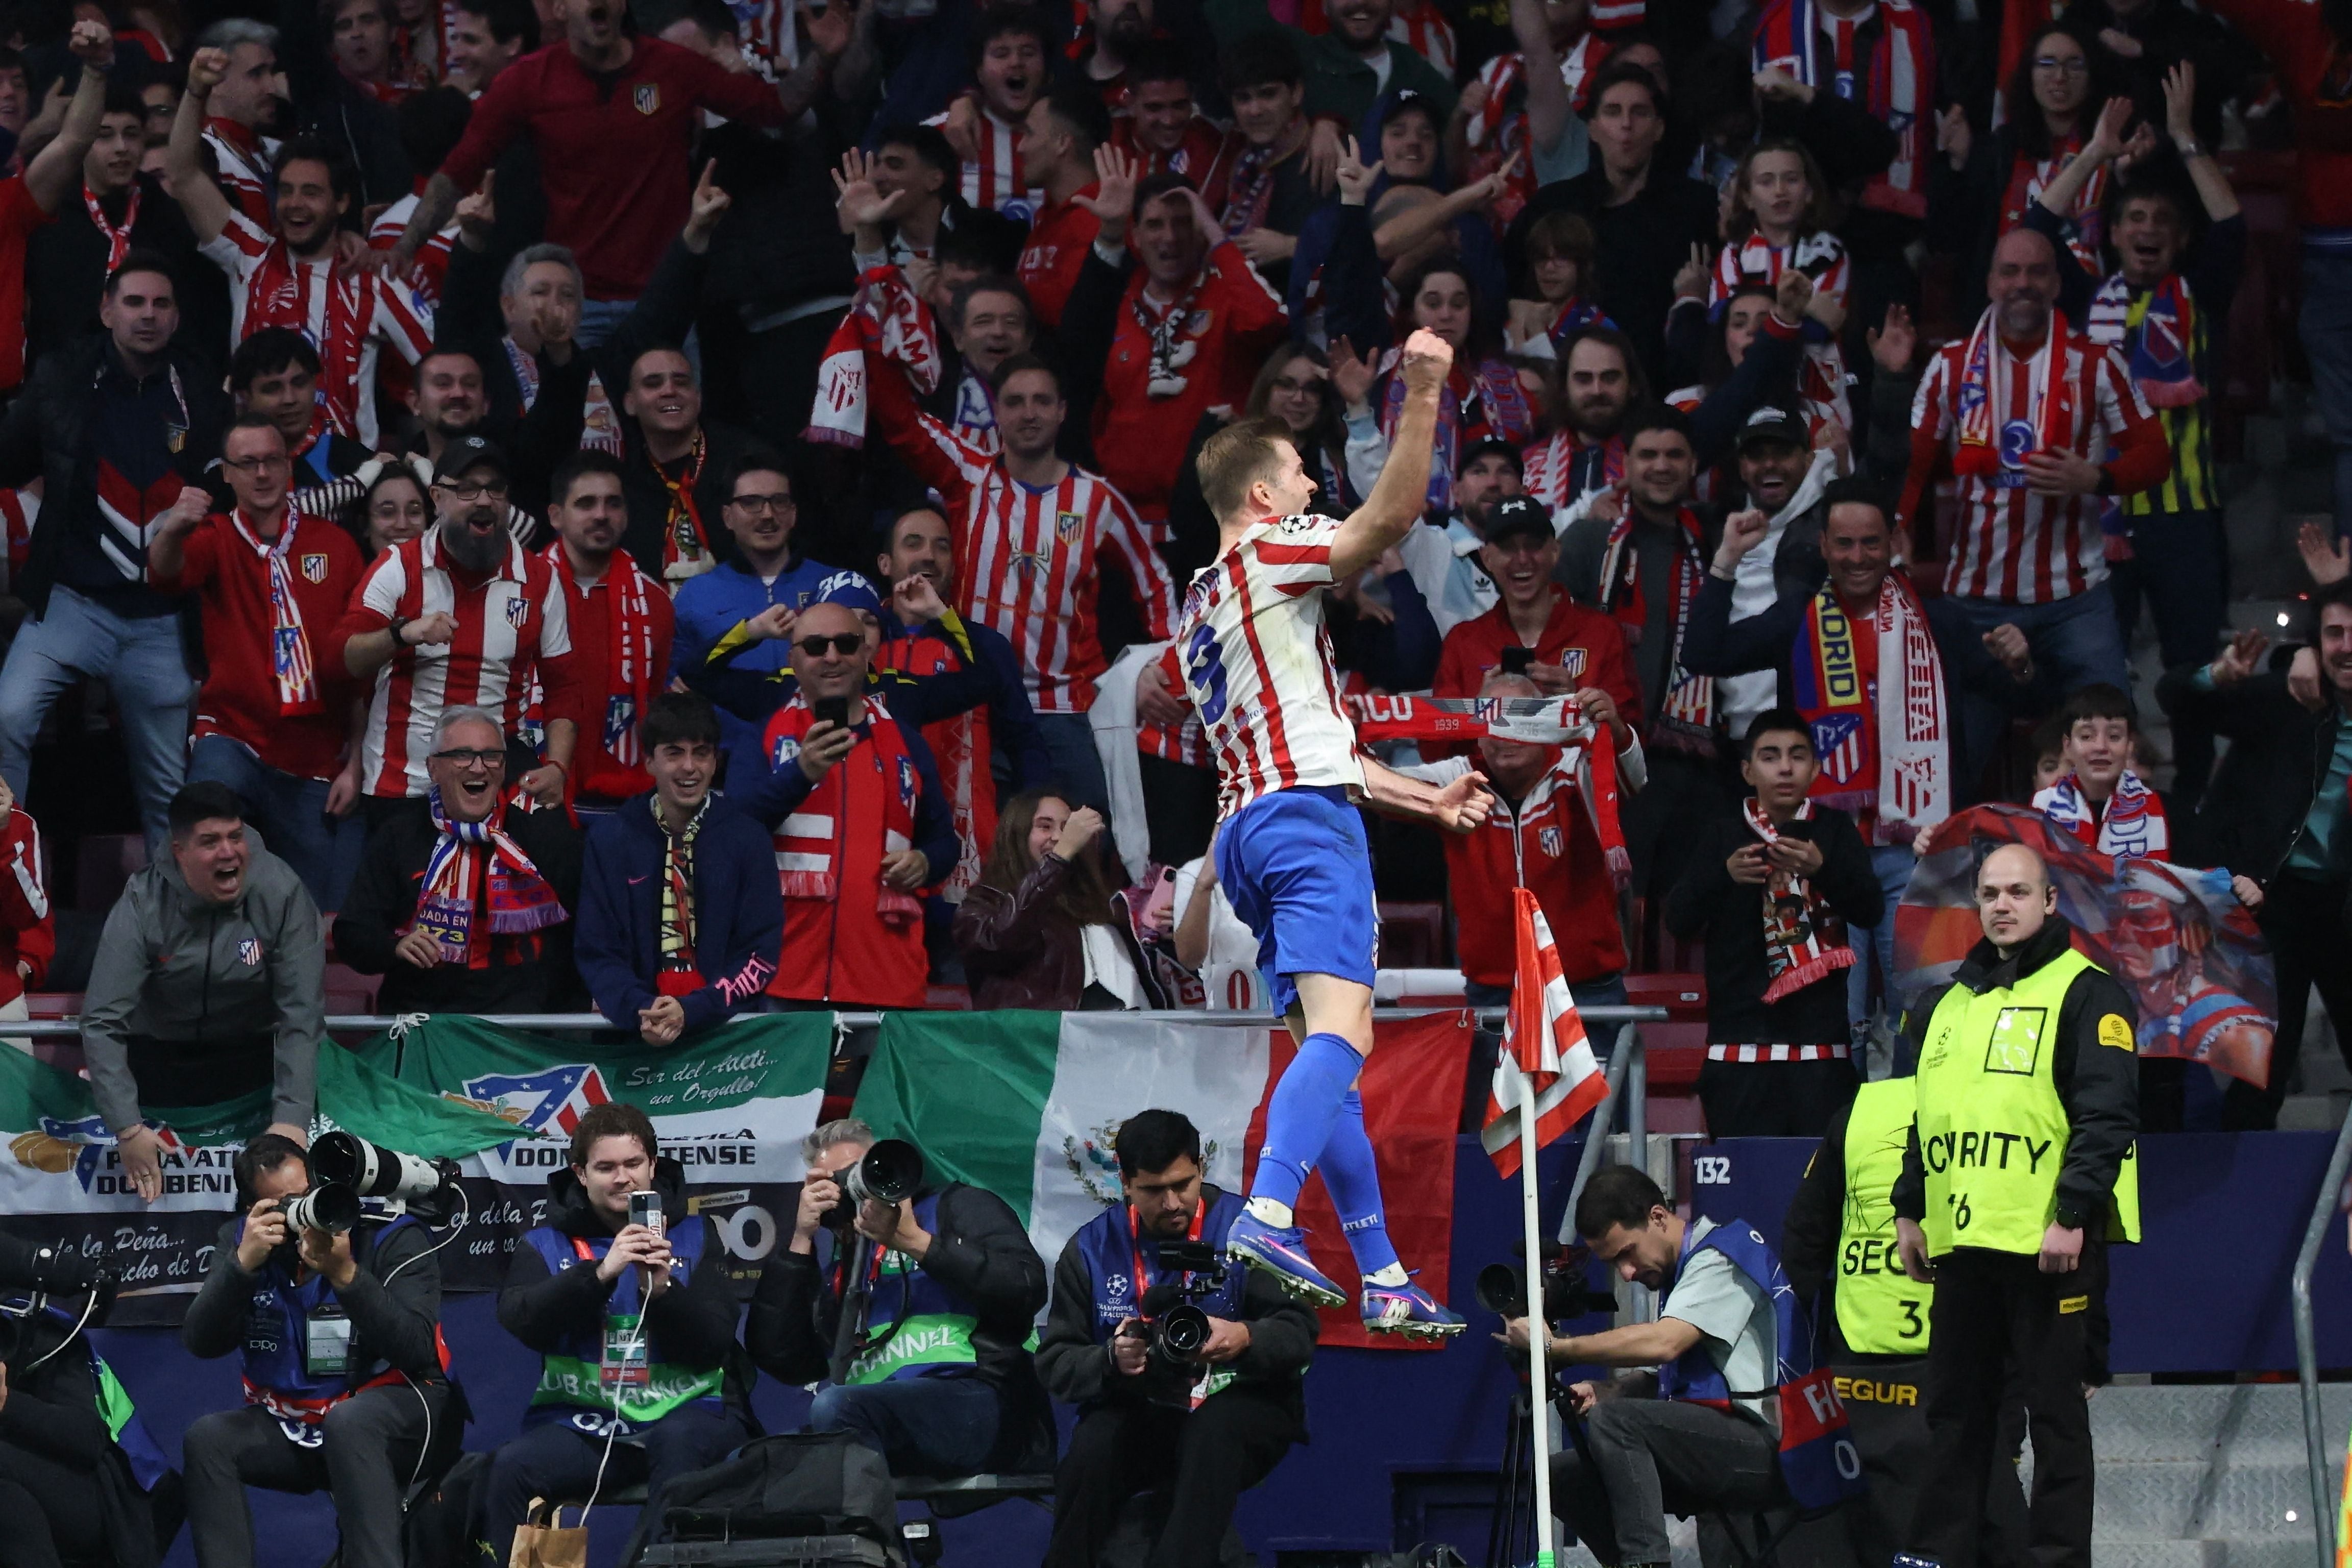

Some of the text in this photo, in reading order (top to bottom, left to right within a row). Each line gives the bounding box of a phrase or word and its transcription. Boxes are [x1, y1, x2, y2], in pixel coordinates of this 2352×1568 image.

[1820, 591, 1856, 698] ADRID
[1186, 623, 1228, 726] 9
[419, 910, 468, 928] DADA EN
[626, 1067, 665, 1087] Ser
[1695, 1156, 1731, 1185] 132
[1342, 1214, 1378, 1232] ATLETI
[845, 1324, 956, 1381] HANNEL
[537, 1369, 581, 1396] UB
[1832, 1376, 1918, 1407] EGUR
